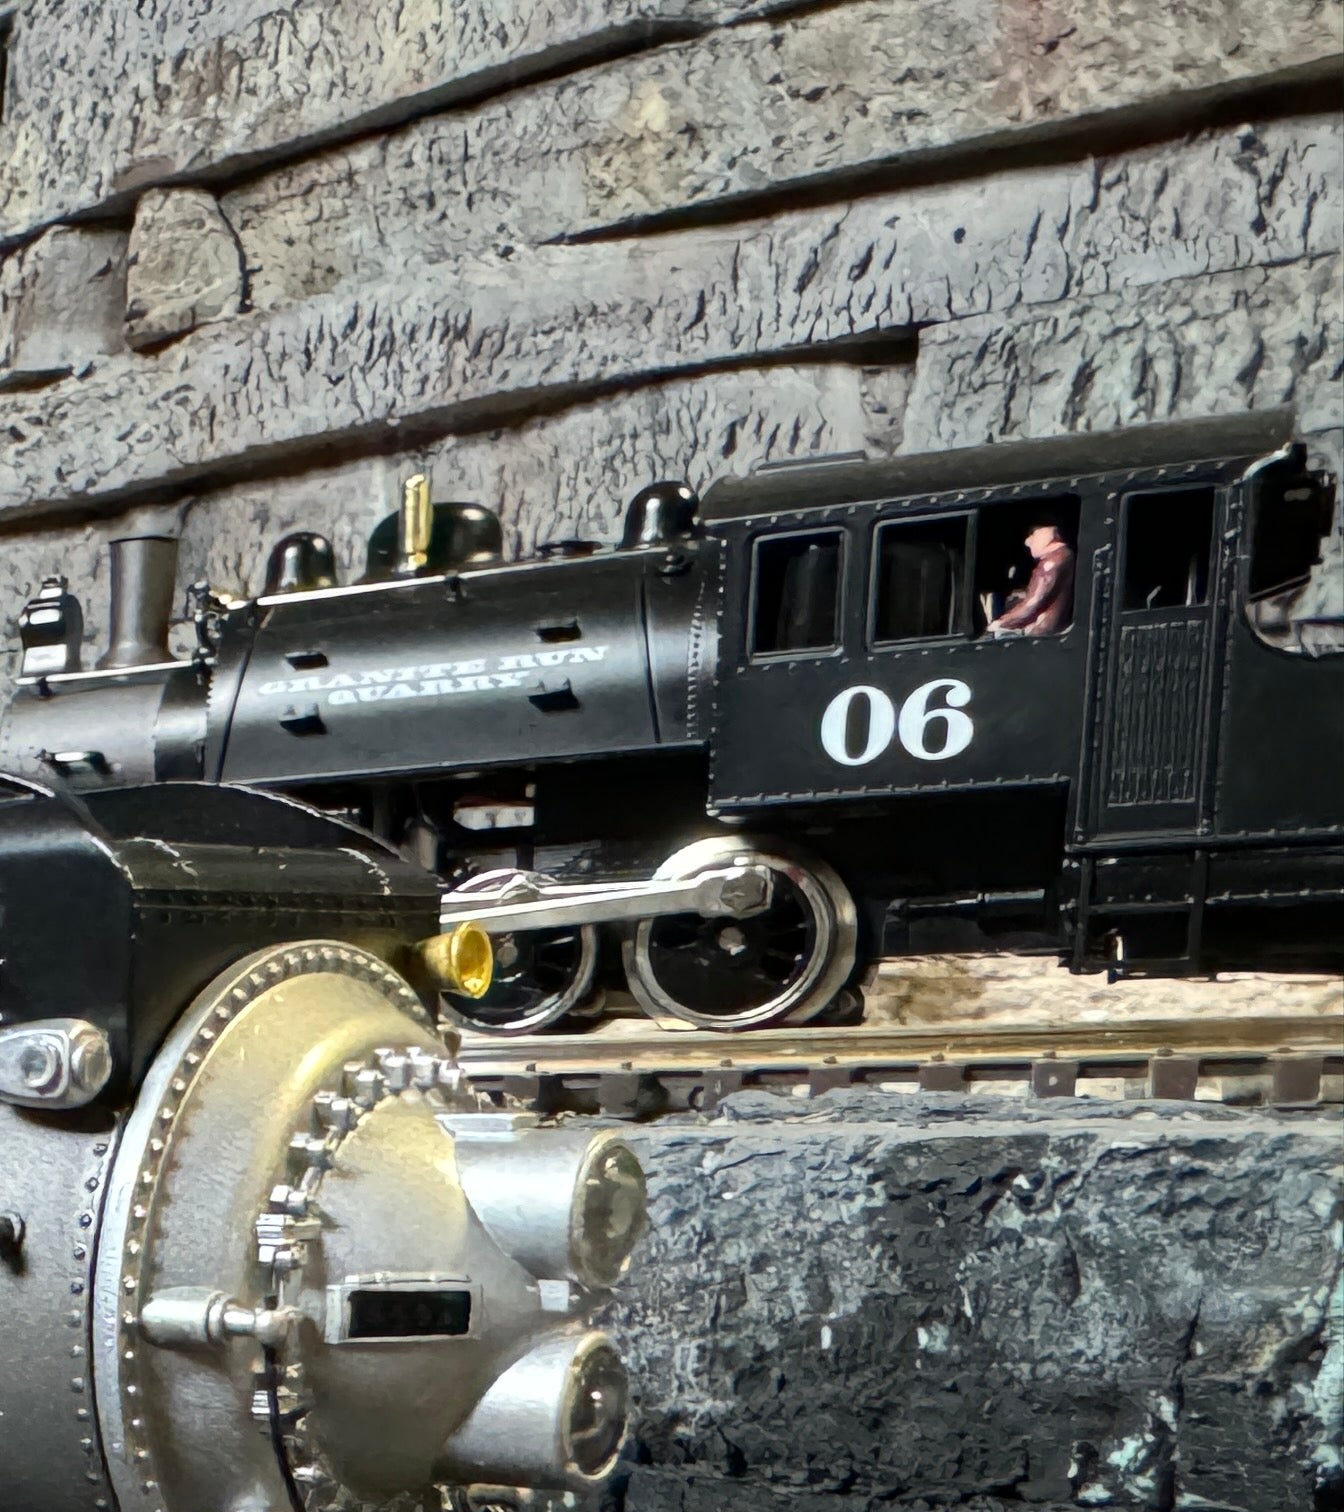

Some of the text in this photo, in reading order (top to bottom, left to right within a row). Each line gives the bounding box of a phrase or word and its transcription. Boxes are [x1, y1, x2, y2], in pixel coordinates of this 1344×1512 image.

[258, 645, 611, 696] GRANITE RUN
[326, 670, 532, 705] QUARRY
[820, 677, 975, 767] 06
